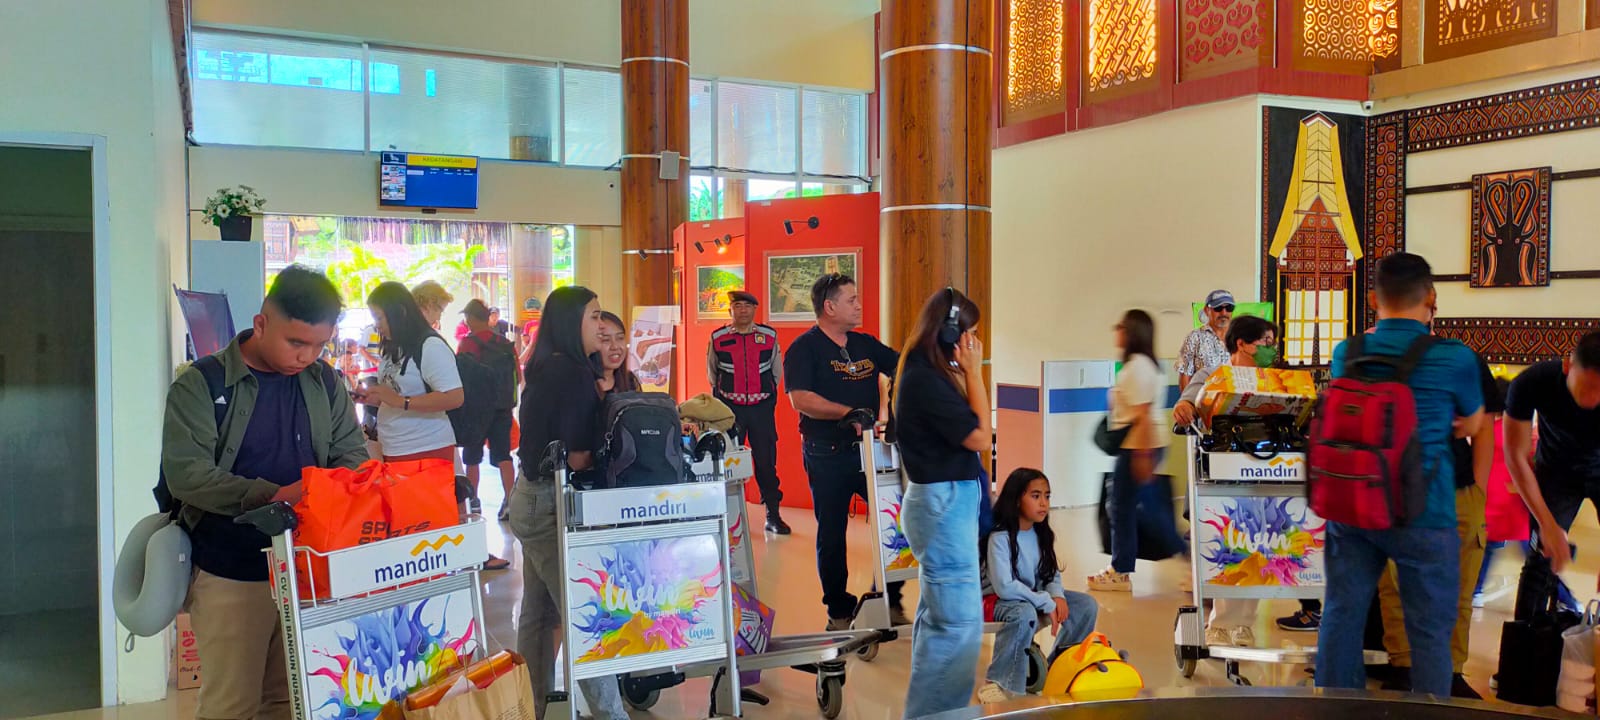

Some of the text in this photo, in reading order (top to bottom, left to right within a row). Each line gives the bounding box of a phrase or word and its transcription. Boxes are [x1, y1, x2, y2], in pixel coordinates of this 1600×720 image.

[1240, 465, 1297, 477] mandiri
[620, 500, 686, 520] mandiri
[374, 552, 447, 584] mandiri
[282, 597, 291, 623] ADHI
[285, 626, 297, 670] BANGUN
